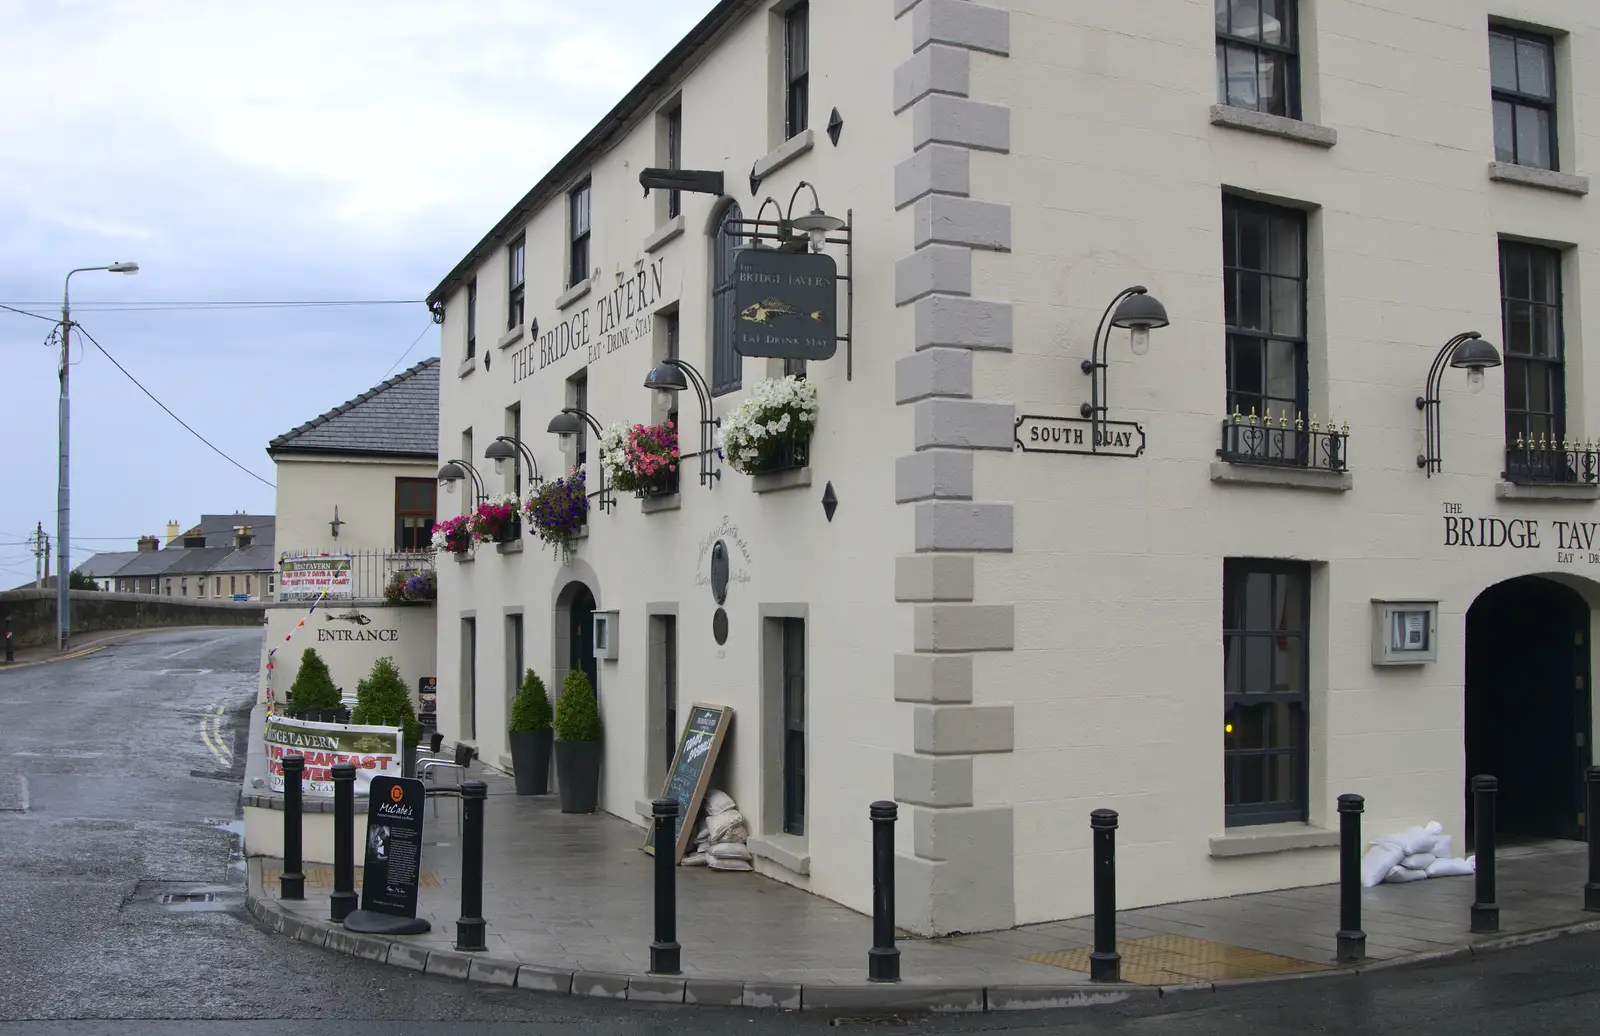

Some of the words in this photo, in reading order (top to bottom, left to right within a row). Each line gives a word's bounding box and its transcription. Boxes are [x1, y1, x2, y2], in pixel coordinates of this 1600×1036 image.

[740, 272, 781, 284] BRIDGE
[789, 275, 831, 287] TAVERN
[512, 343, 535, 385] THE
[540, 308, 590, 370] BRIDGE
[597, 257, 664, 337] TAVERN
[588, 342, 602, 364] EAT
[607, 327, 630, 355] DRINK
[634, 313, 653, 340] STAY
[743, 333, 760, 343] EAT
[766, 335, 800, 345] DRINK
[805, 338, 828, 347] STAY
[1030, 426, 1084, 444] SOUTH
[1096, 430, 1132, 447] QUAY
[1443, 502, 1463, 514] THE
[1443, 516, 1541, 549] BRIDGE
[1552, 520, 1600, 550] TAV
[1557, 551, 1575, 564] EAT
[317, 629, 399, 641] ENTRANCE
[302, 766, 334, 781] WEE
[379, 802, 413, 816] McCabe's
